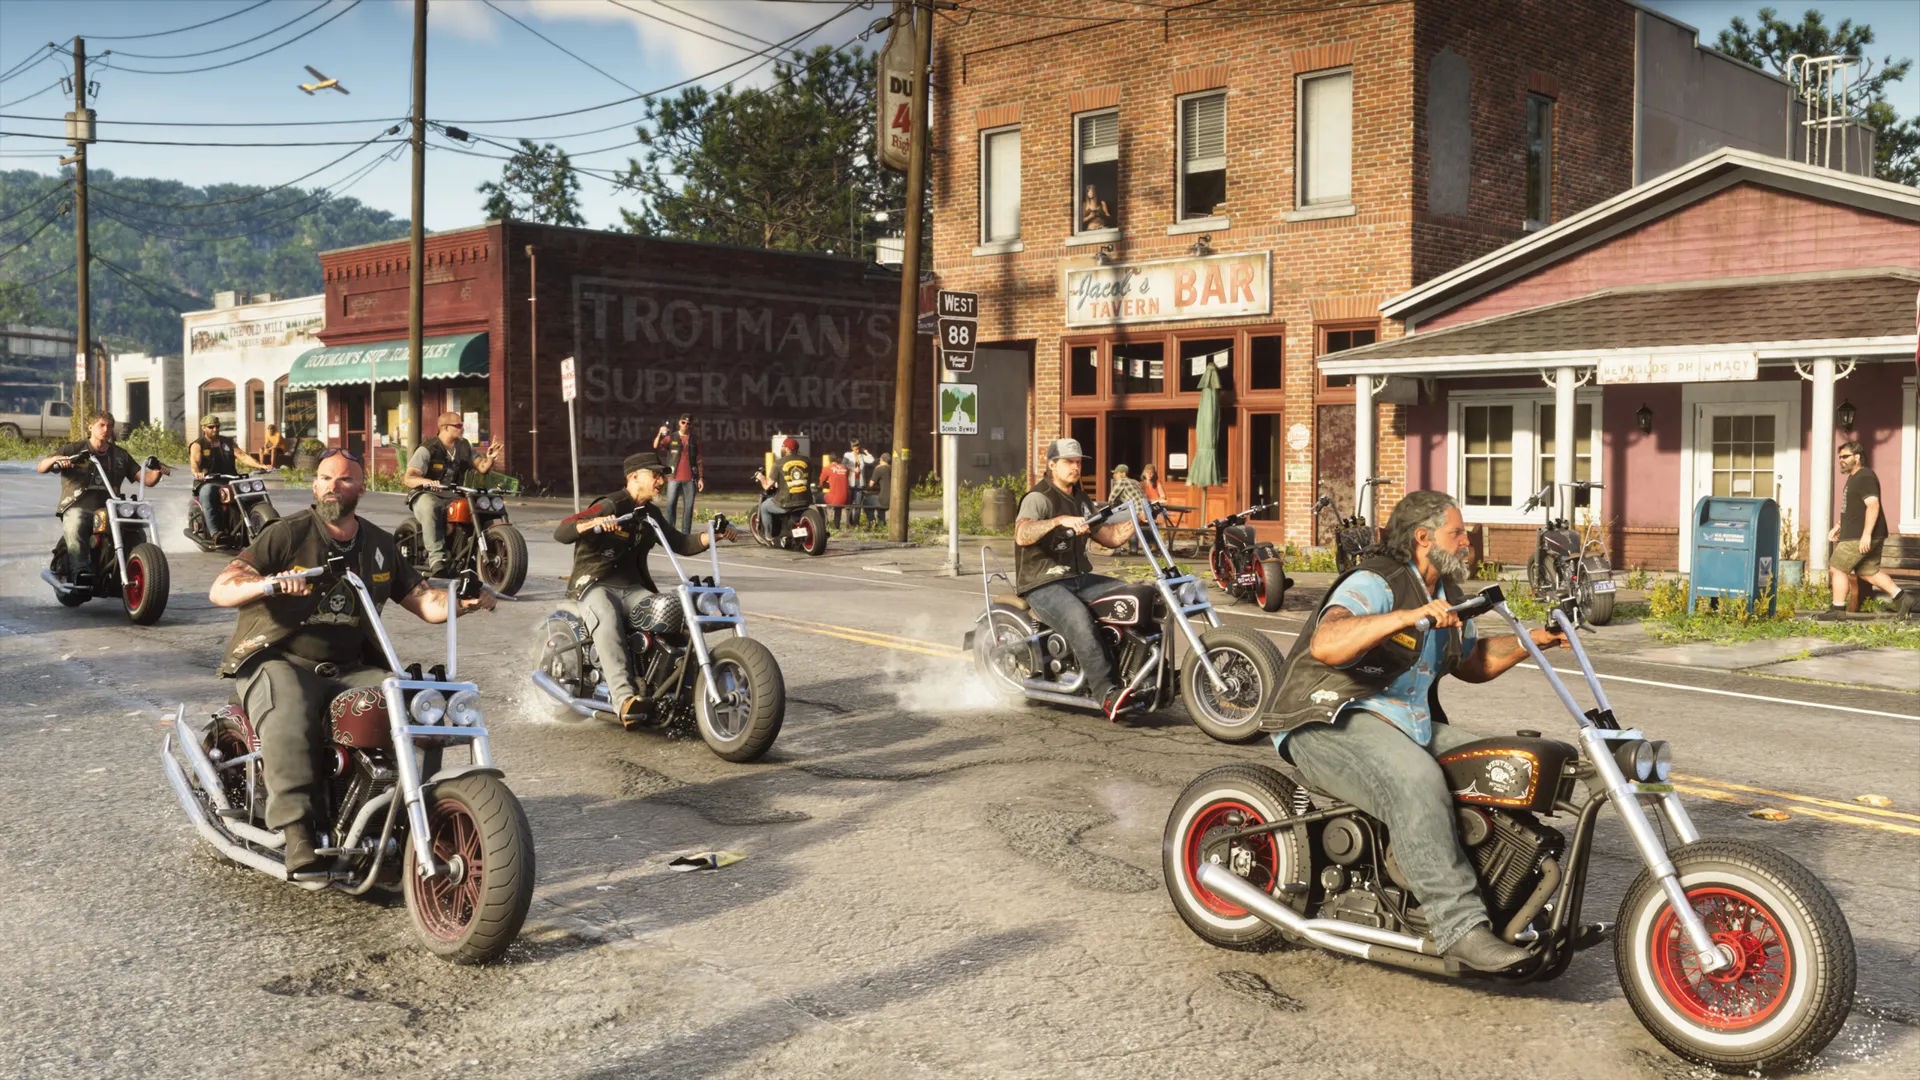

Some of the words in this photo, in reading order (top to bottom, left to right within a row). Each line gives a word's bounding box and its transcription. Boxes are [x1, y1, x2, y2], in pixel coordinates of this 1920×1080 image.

[1174, 263, 1256, 308] BAR
[944, 294, 974, 313] WEST
[1090, 297, 1159, 319] TAVERN
[245, 325, 261, 337] OLD
[264, 321, 284, 334] MILL
[582, 292, 893, 359] TROTMAN'S
[948, 325, 969, 345] 88
[1678, 360, 1749, 373] PHRMACY
[585, 362, 728, 406] SUPER
[742, 372, 896, 411] MARKET
[584, 416, 645, 440] MEAT
[802, 421, 893, 444] GROCERIES
[1485, 759, 1516, 777] WESTERN
